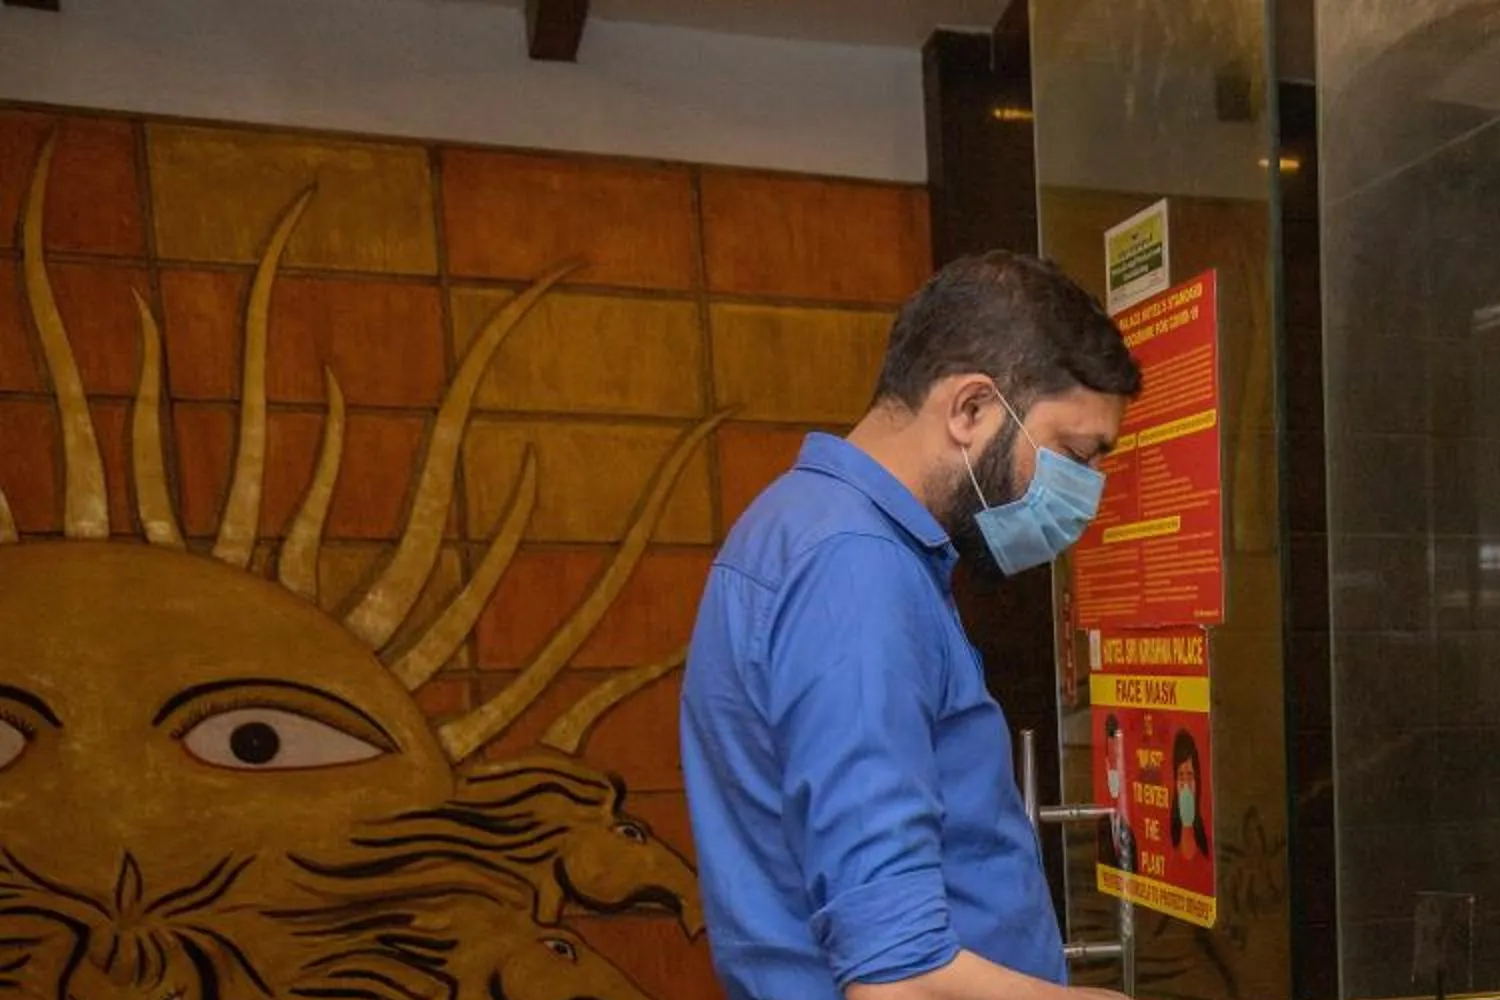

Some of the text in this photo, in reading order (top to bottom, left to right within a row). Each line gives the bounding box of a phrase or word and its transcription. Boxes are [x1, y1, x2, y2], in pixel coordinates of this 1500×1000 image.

[1172, 636, 1203, 665] PALACE
[1115, 679, 1177, 705] FACE MASK
[1132, 781, 1169, 809] TO ENTER
[1144, 817, 1161, 841] THE
